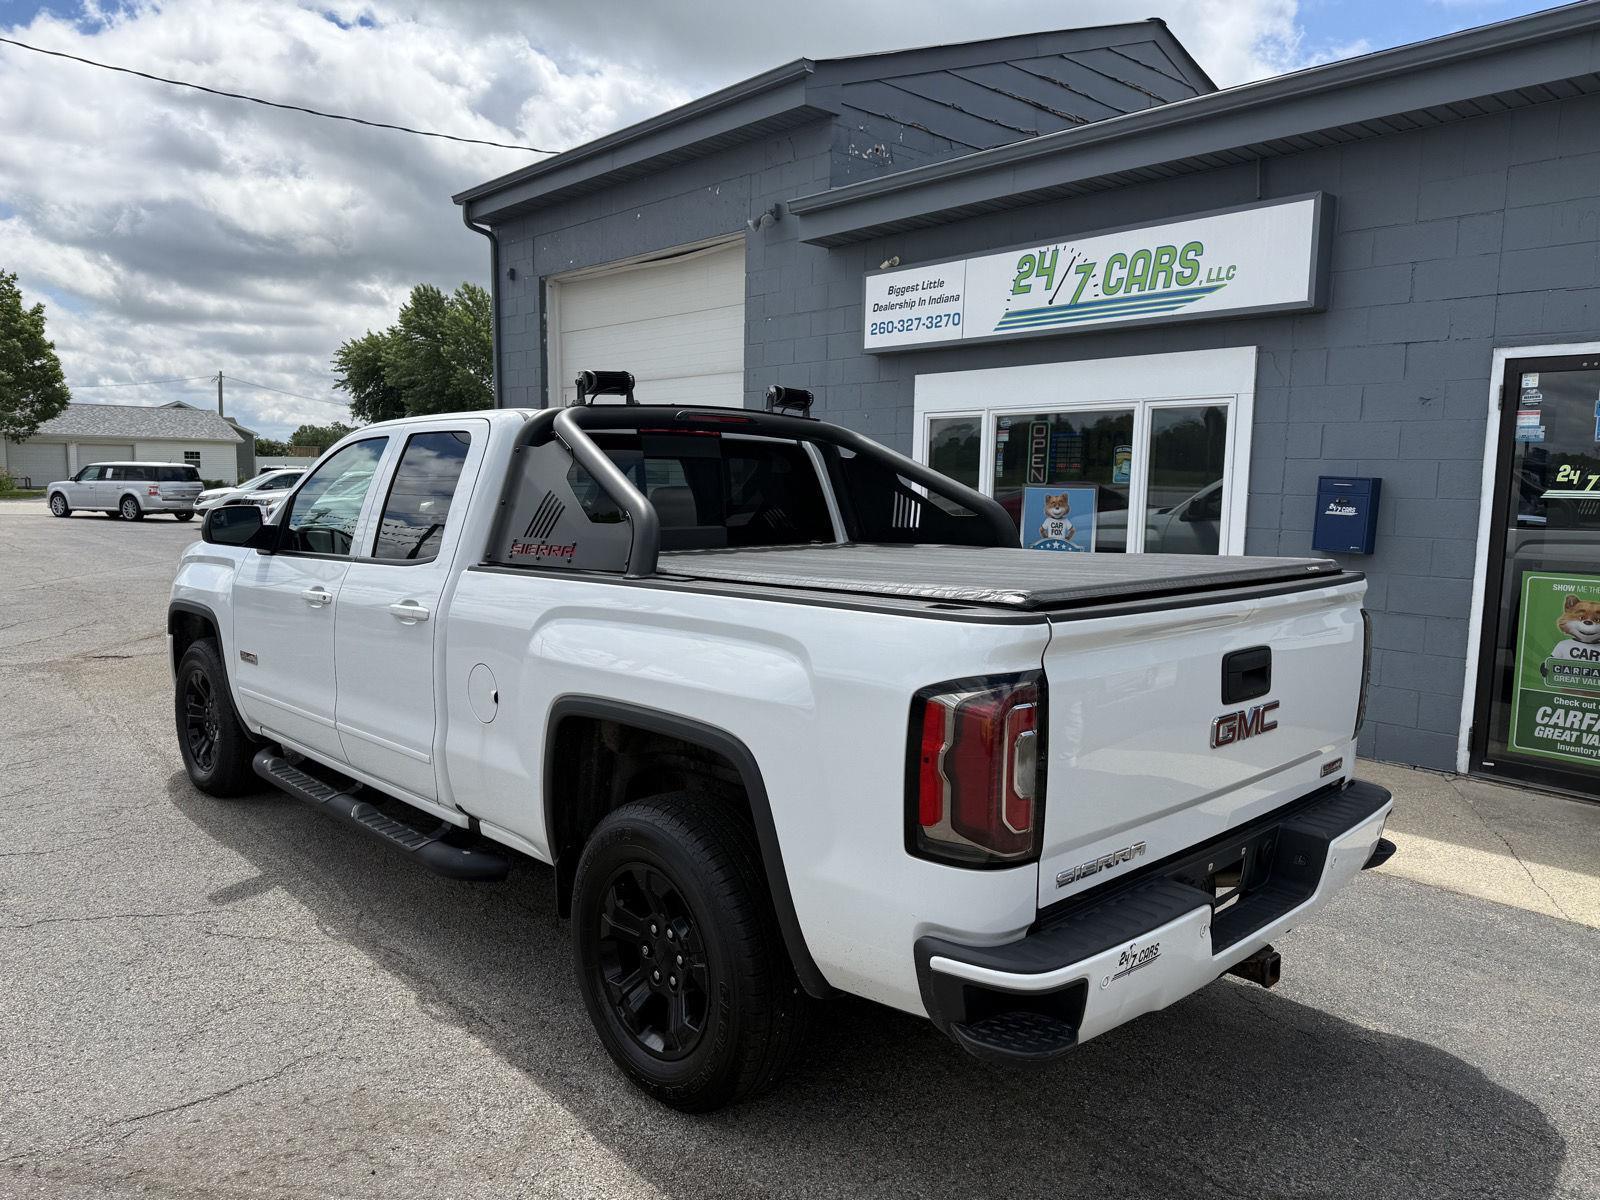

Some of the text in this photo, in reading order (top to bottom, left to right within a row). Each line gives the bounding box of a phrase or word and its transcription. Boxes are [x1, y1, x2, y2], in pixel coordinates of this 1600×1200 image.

[888, 278, 945, 297] Biggest Little
[872, 294, 960, 312] Dealership In Indiana
[870, 312, 961, 336] 260-327-3270
[1031, 425, 1047, 482] OPEN
[511, 543, 576, 558] SIERRA
[1552, 583, 1576, 592] SHOW
[1576, 585, 1588, 593] ME
[1570, 647, 1600, 661] CAR
[1553, 674, 1580, 684] GREAT
[1554, 696, 1596, 710] Check out
[1210, 700, 1279, 749] GMC
[1534, 725, 1600, 747] GREAT VA
[1056, 841, 1147, 889] SIERRA
[1138, 942, 1160, 963] CARS
